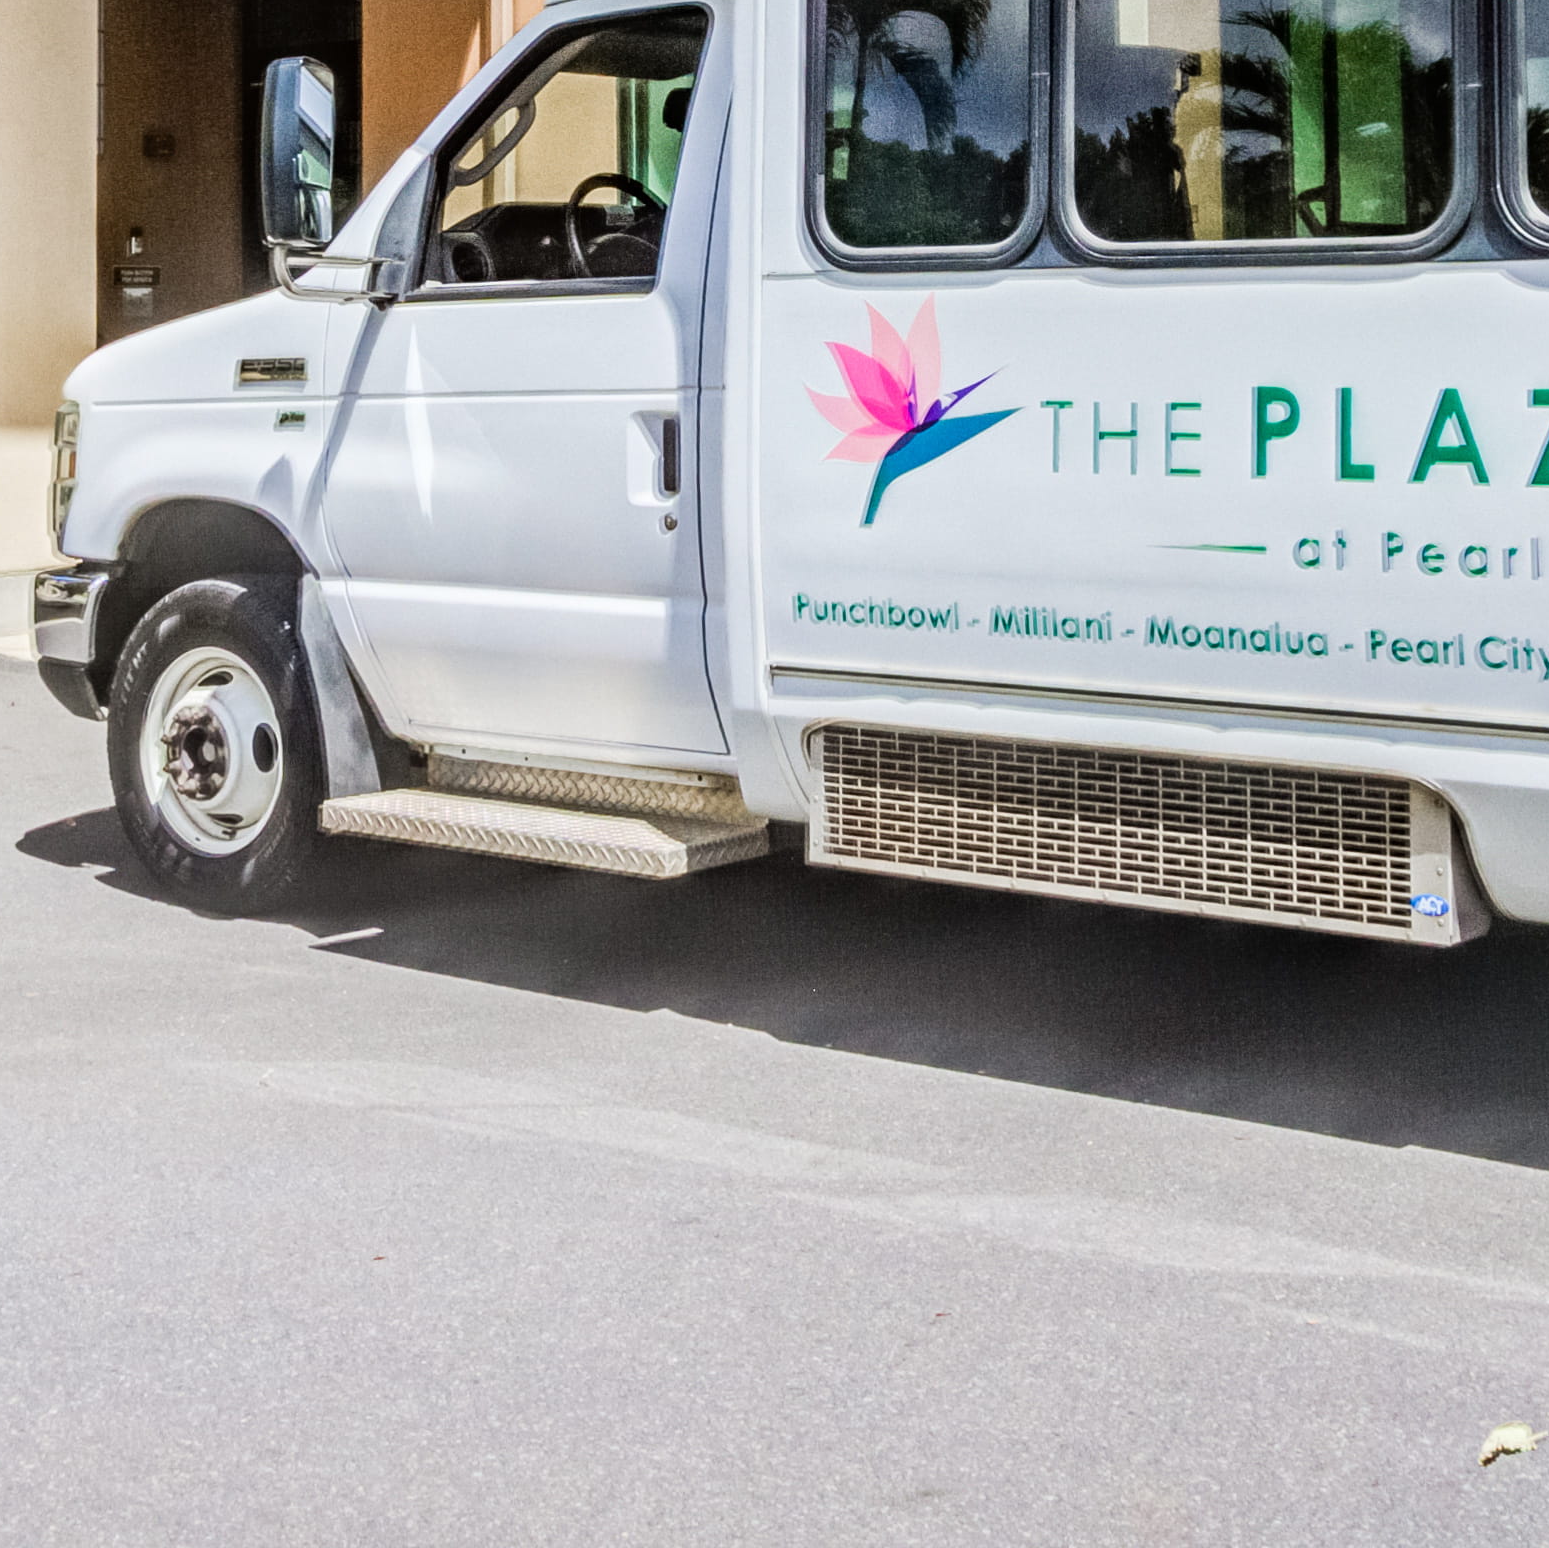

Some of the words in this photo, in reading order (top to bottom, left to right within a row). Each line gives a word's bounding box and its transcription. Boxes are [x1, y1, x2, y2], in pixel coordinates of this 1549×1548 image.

[1041, 400, 1202, 477] THE
[1293, 530, 1346, 571] at
[1382, 531, 1540, 580] Pearl
[792, 592, 960, 635] Punchbowl
[989, 605, 1113, 643] Mililani
[1143, 615, 1329, 658] Moanalua
[1366, 629, 1465, 668] Pearl
